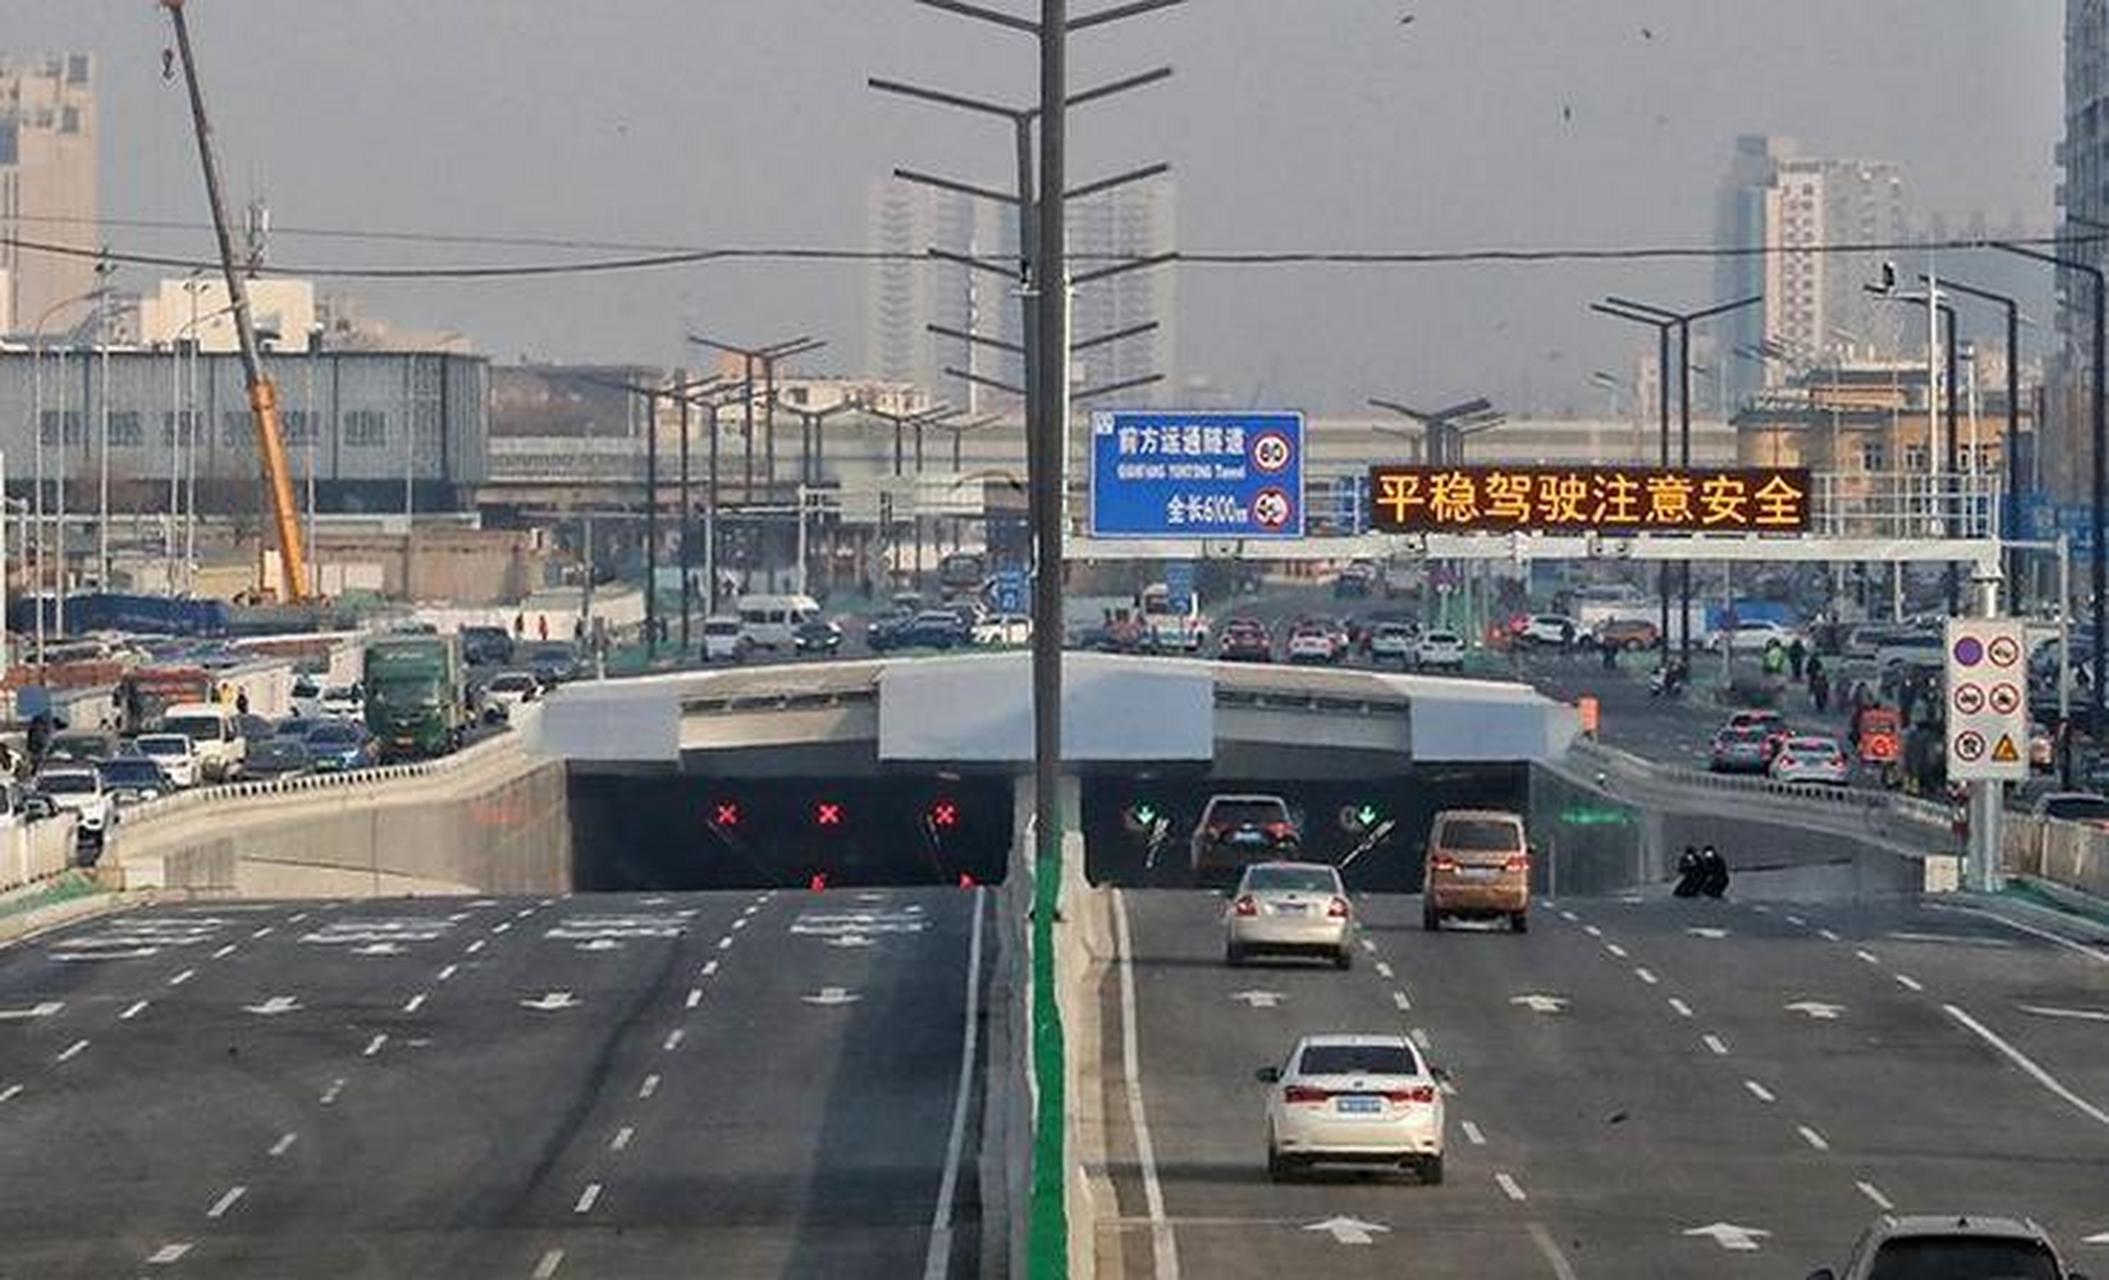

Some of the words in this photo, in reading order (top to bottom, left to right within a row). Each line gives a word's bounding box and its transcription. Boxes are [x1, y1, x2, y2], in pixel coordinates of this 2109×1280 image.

[1260, 442, 1285, 463] 80
[1376, 472, 1805, 524] 平稳驾驶注意安全
